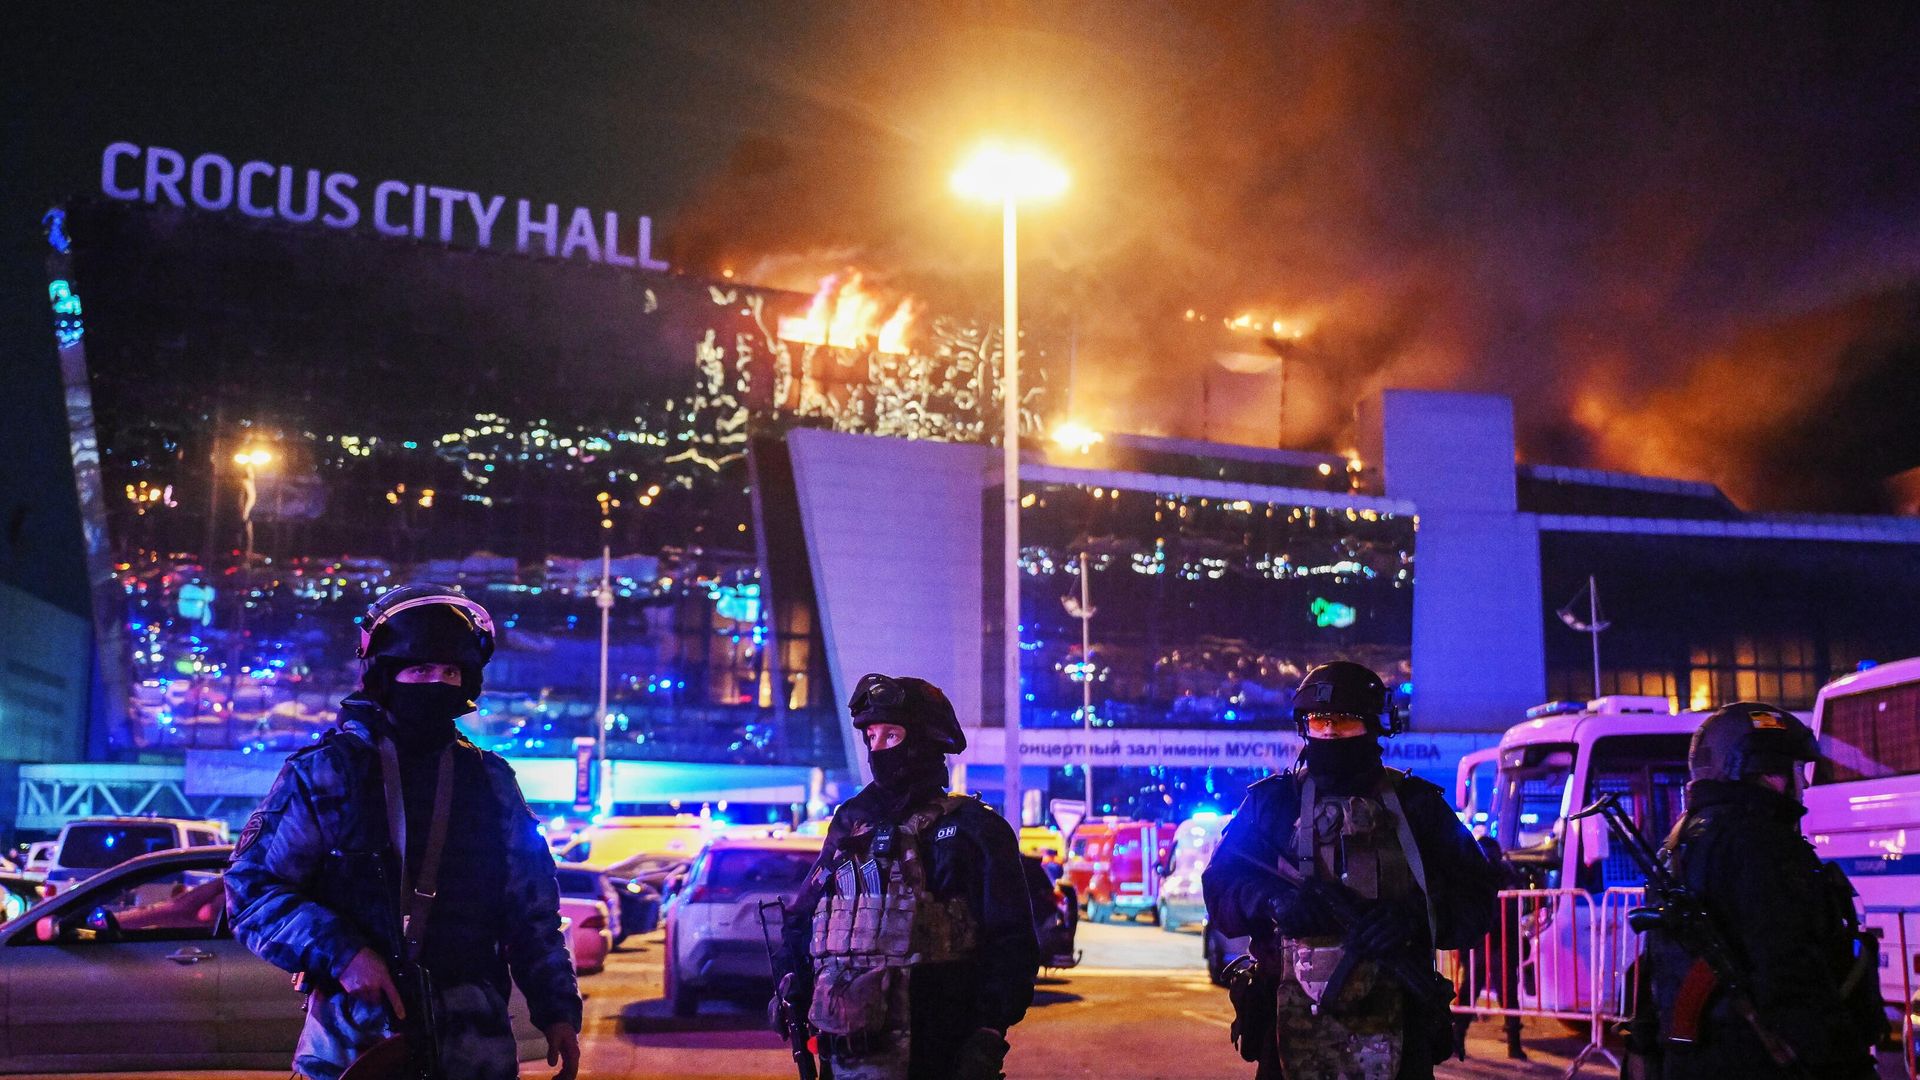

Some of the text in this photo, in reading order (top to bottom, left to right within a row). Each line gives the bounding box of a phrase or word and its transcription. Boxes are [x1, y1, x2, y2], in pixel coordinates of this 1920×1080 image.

[101, 141, 670, 271] CROCUS CITY HALL
[1019, 740, 1121, 759] онцертный
[1126, 744, 1157, 756] зал
[1162, 744, 1220, 757] имени
[1382, 742, 1441, 760] АЕВА
